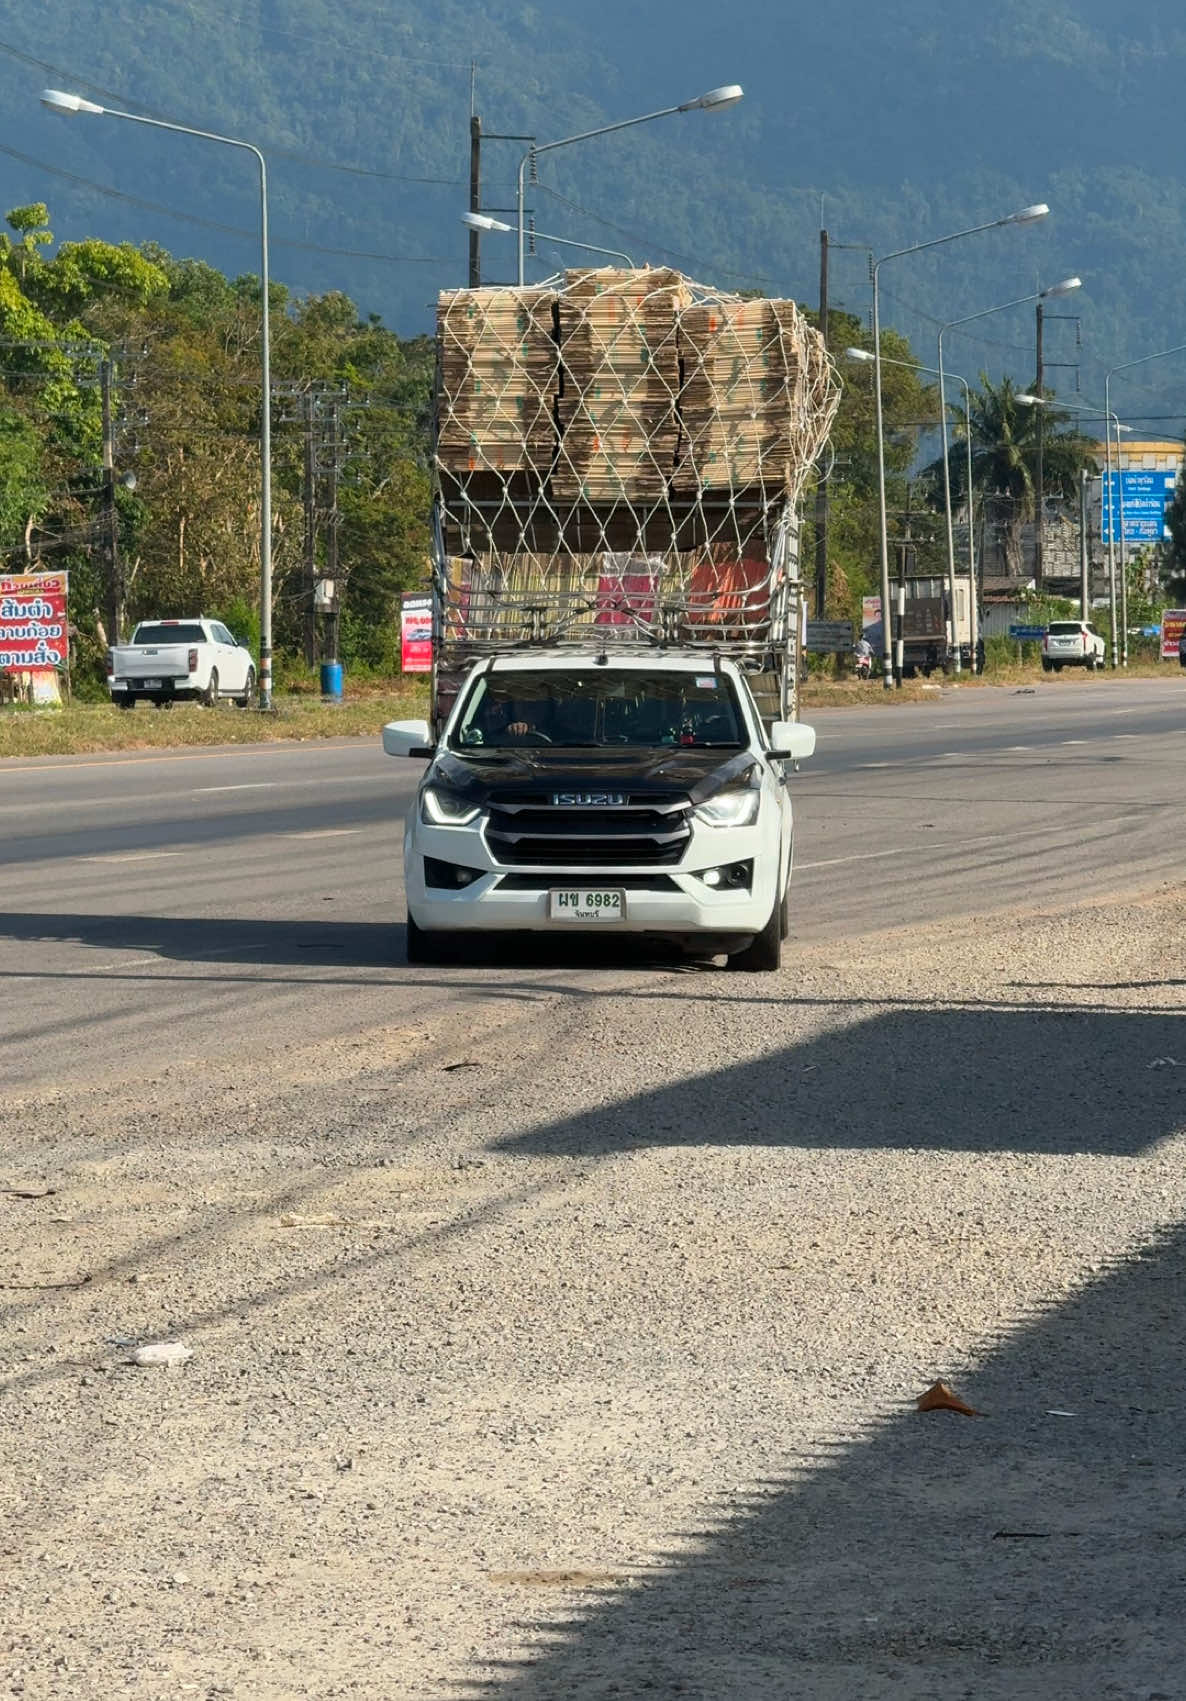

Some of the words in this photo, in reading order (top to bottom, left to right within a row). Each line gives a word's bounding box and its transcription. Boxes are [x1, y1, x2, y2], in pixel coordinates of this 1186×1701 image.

[1, 599, 52, 617] ส้มตำ
[0, 641, 59, 664] ตามสั่ง
[553, 794, 623, 805] ISUZU
[586, 894, 619, 907] 6982
